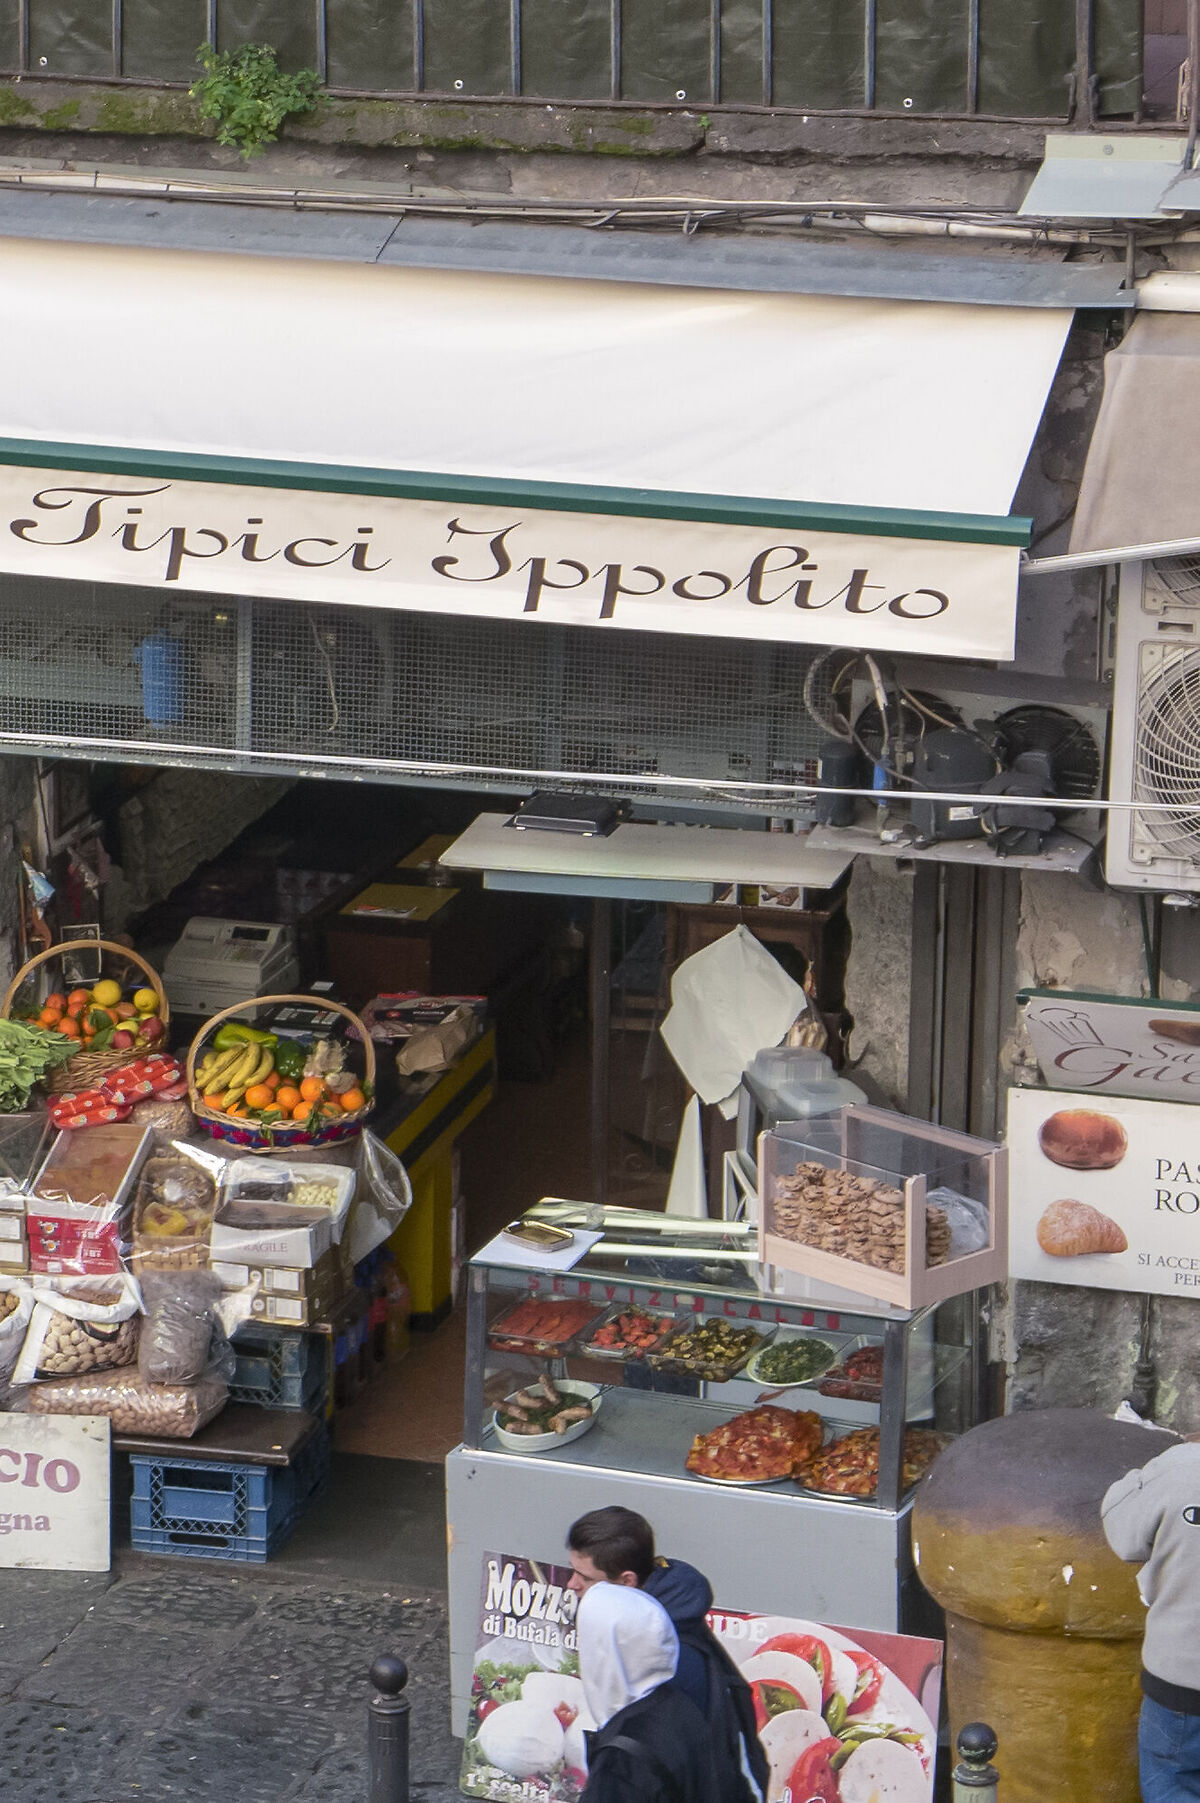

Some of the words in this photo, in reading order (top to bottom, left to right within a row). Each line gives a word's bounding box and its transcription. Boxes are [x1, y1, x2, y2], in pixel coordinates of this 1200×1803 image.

[9, 484, 392, 580] Tipici
[431, 517, 950, 619] Ippolito
[1155, 1158, 1200, 1184] PA
[482, 1614, 502, 1636] di
[503, 1615, 561, 1646] Bufala
[705, 1613, 769, 1643] IDE
